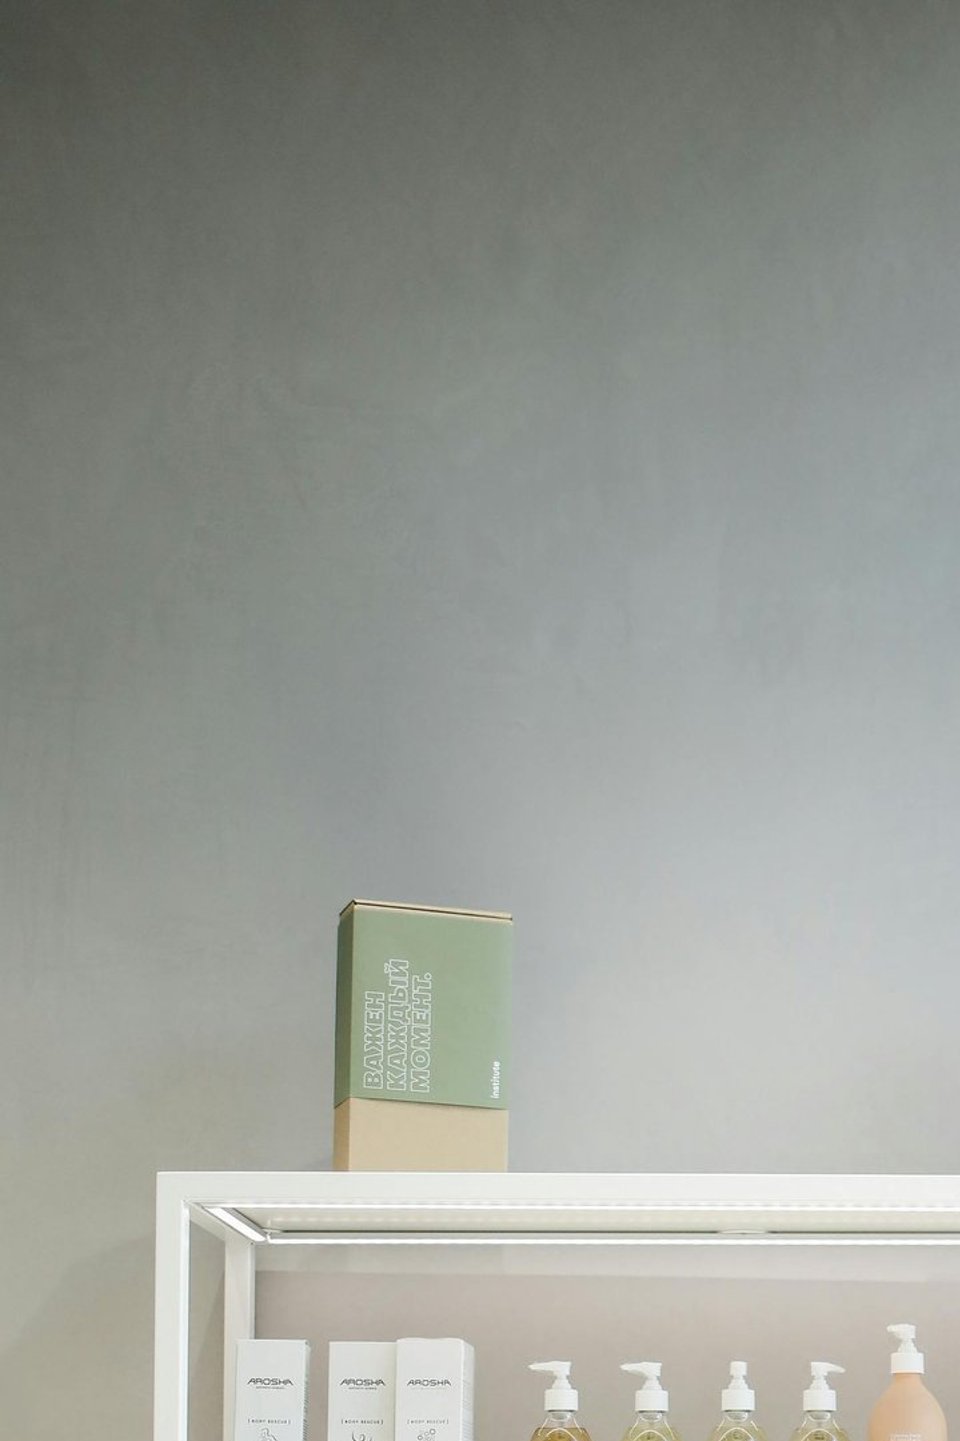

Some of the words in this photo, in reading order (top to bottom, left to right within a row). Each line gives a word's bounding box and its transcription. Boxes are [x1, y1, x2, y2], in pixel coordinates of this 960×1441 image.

[363, 991, 385, 1089] ВАЖЕН
[384, 958, 410, 1090] КАЖДЫЙ
[411, 972, 432, 1093] МОМЕНТ.
[247, 1377, 294, 1386] AROSHA
[340, 1378, 386, 1387] AROSHA
[407, 1379, 452, 1387] AROSHA
